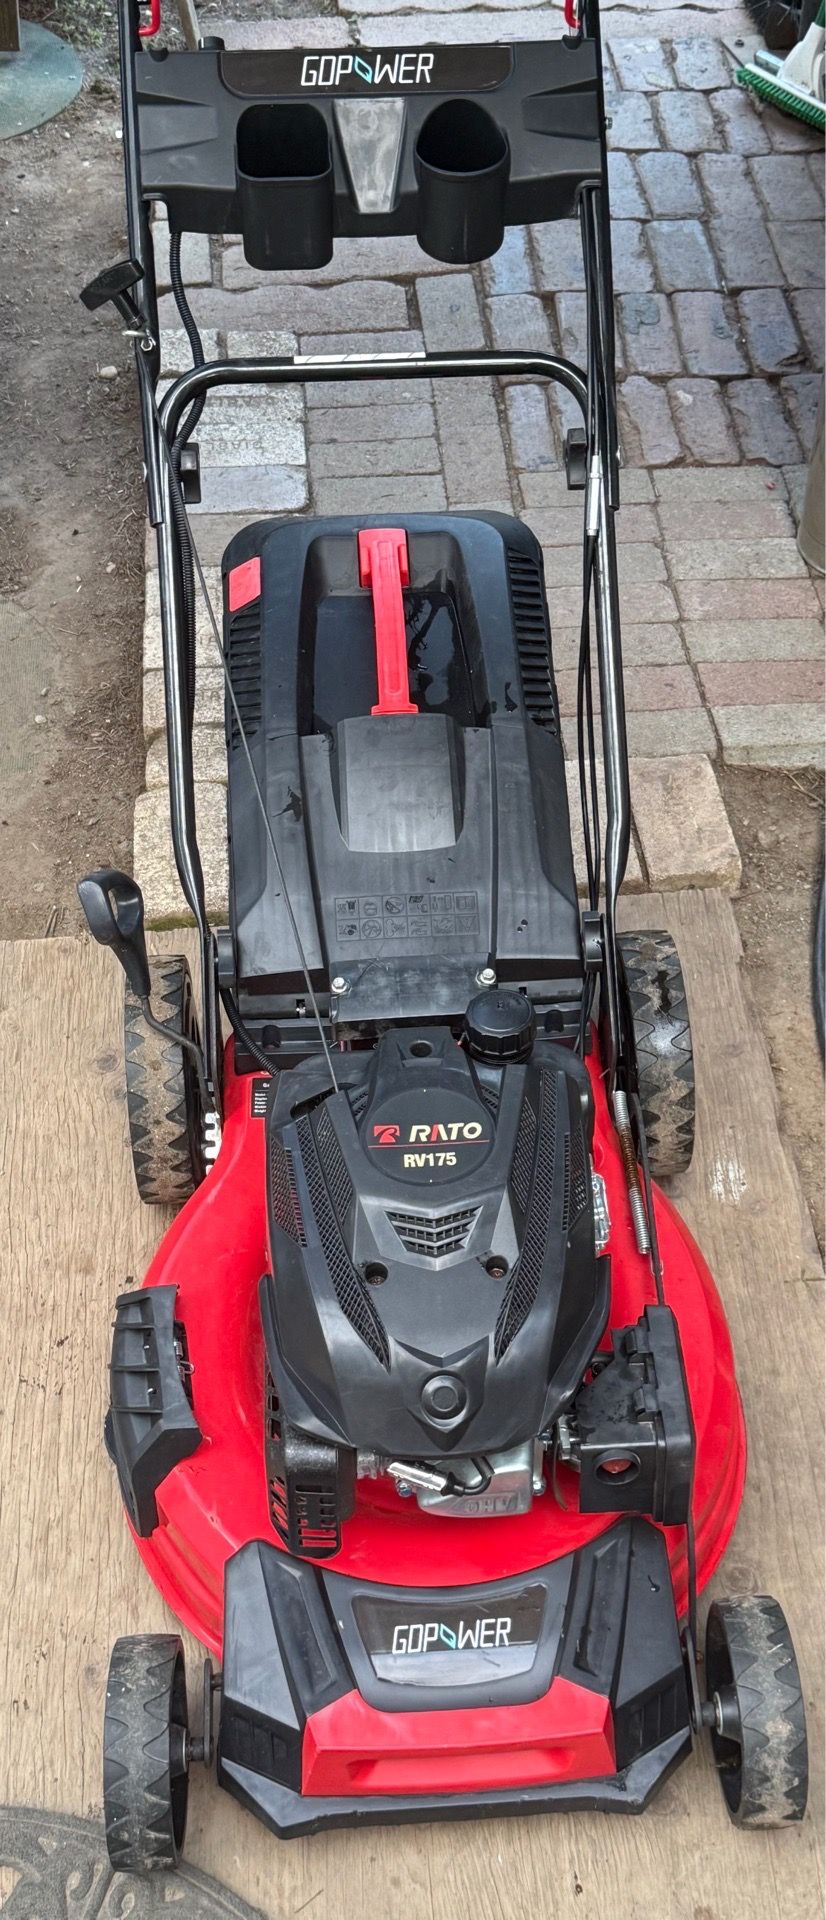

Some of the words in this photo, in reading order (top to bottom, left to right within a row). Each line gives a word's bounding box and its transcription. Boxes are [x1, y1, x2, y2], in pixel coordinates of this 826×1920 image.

[300, 53, 434, 86] GOPOWER
[408, 1122, 483, 1142] RATO
[403, 1152, 457, 1168] RV175
[392, 1617, 511, 1654] GOPOWER
